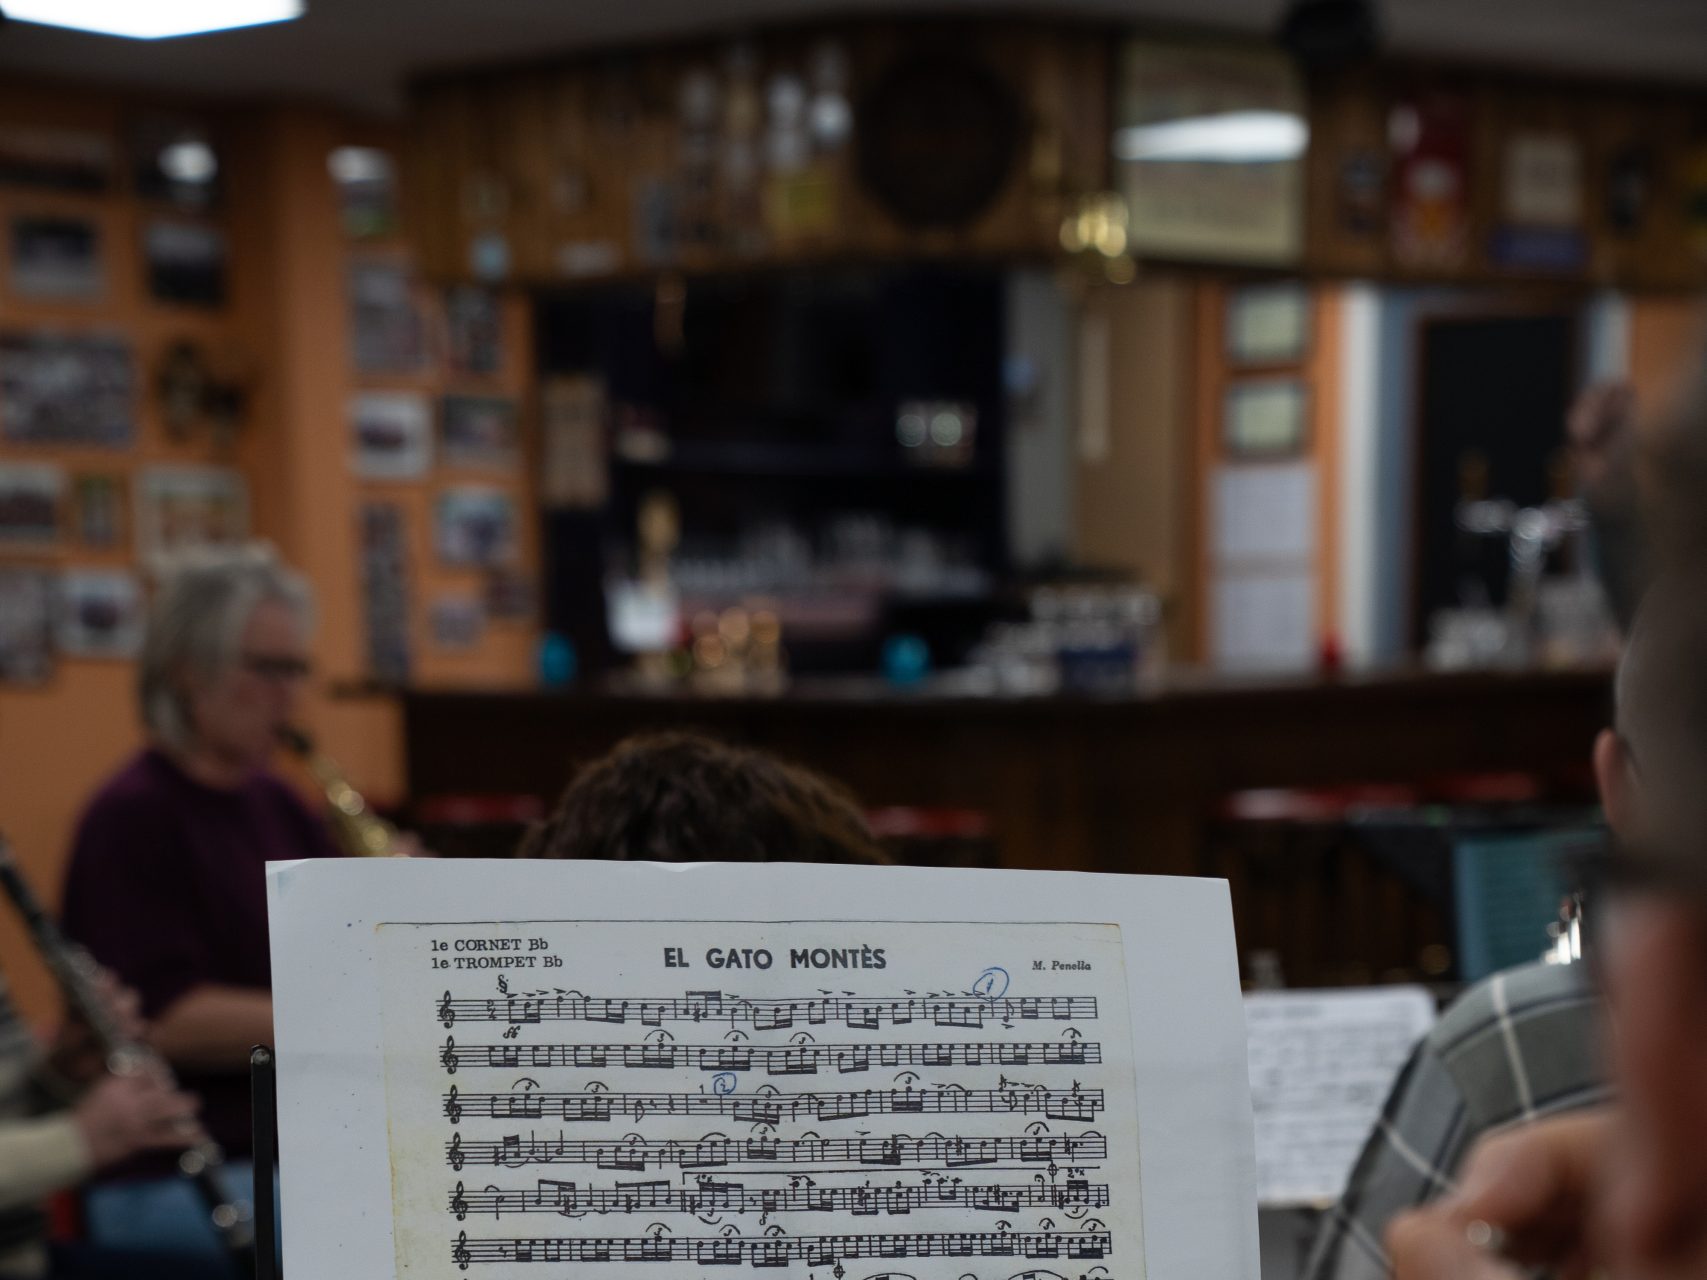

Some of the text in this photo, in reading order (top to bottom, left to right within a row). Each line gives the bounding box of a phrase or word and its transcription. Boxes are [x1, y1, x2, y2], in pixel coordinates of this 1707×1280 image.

[431, 937, 549, 952] 1e CORNET Bb
[431, 955, 563, 969] 1e TROMPET Bb
[663, 943, 887, 970] EL GATO MONTÈS
[1031, 960, 1092, 971] M. Penella
